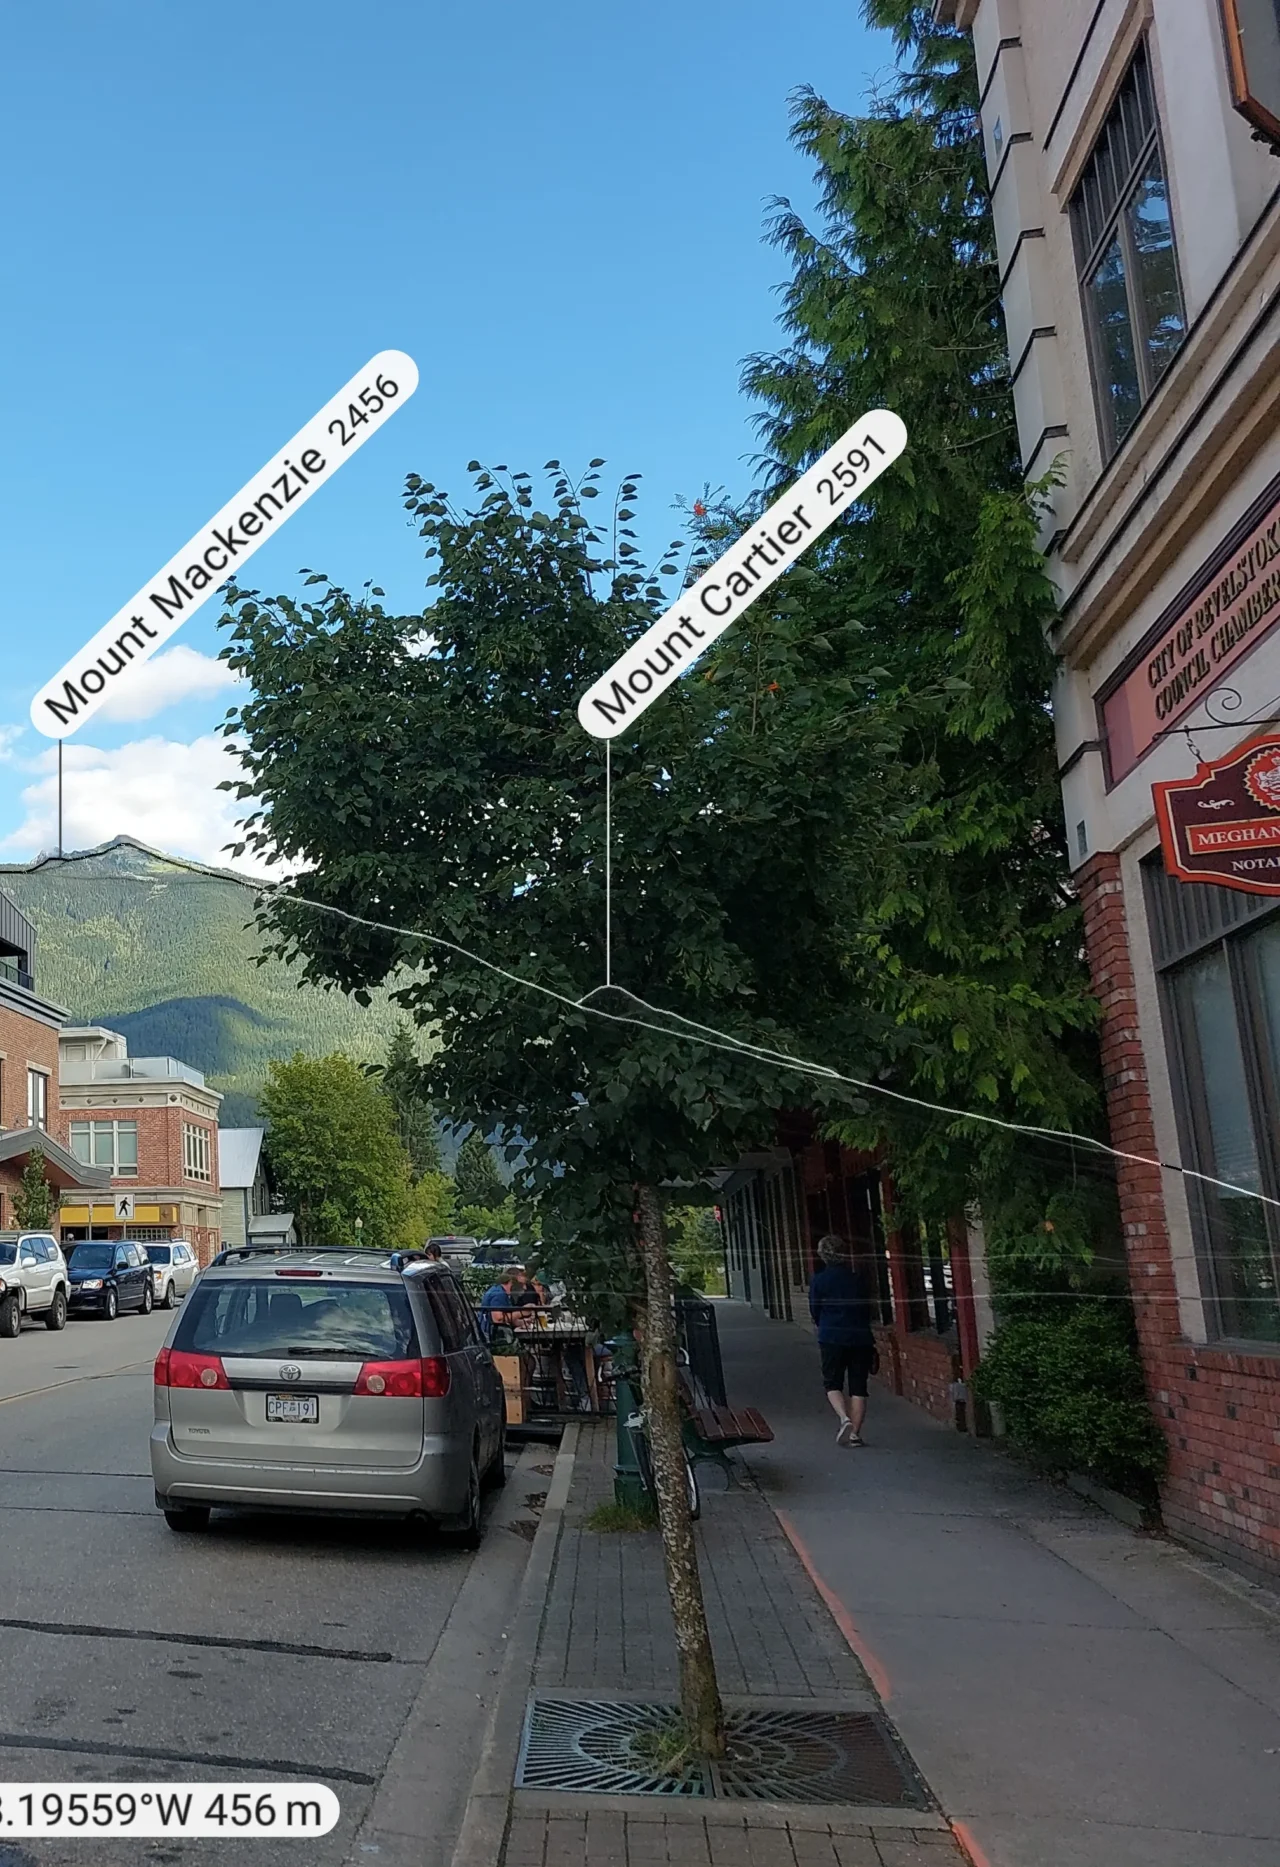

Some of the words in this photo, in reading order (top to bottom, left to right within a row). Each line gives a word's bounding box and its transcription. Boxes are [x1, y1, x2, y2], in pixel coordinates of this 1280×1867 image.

[1148, 639, 1175, 689] CITY
[1176, 618, 1194, 657] OF
[1194, 516, 1280, 640] REVELSTOK
[1154, 648, 1211, 721] COUNCIL
